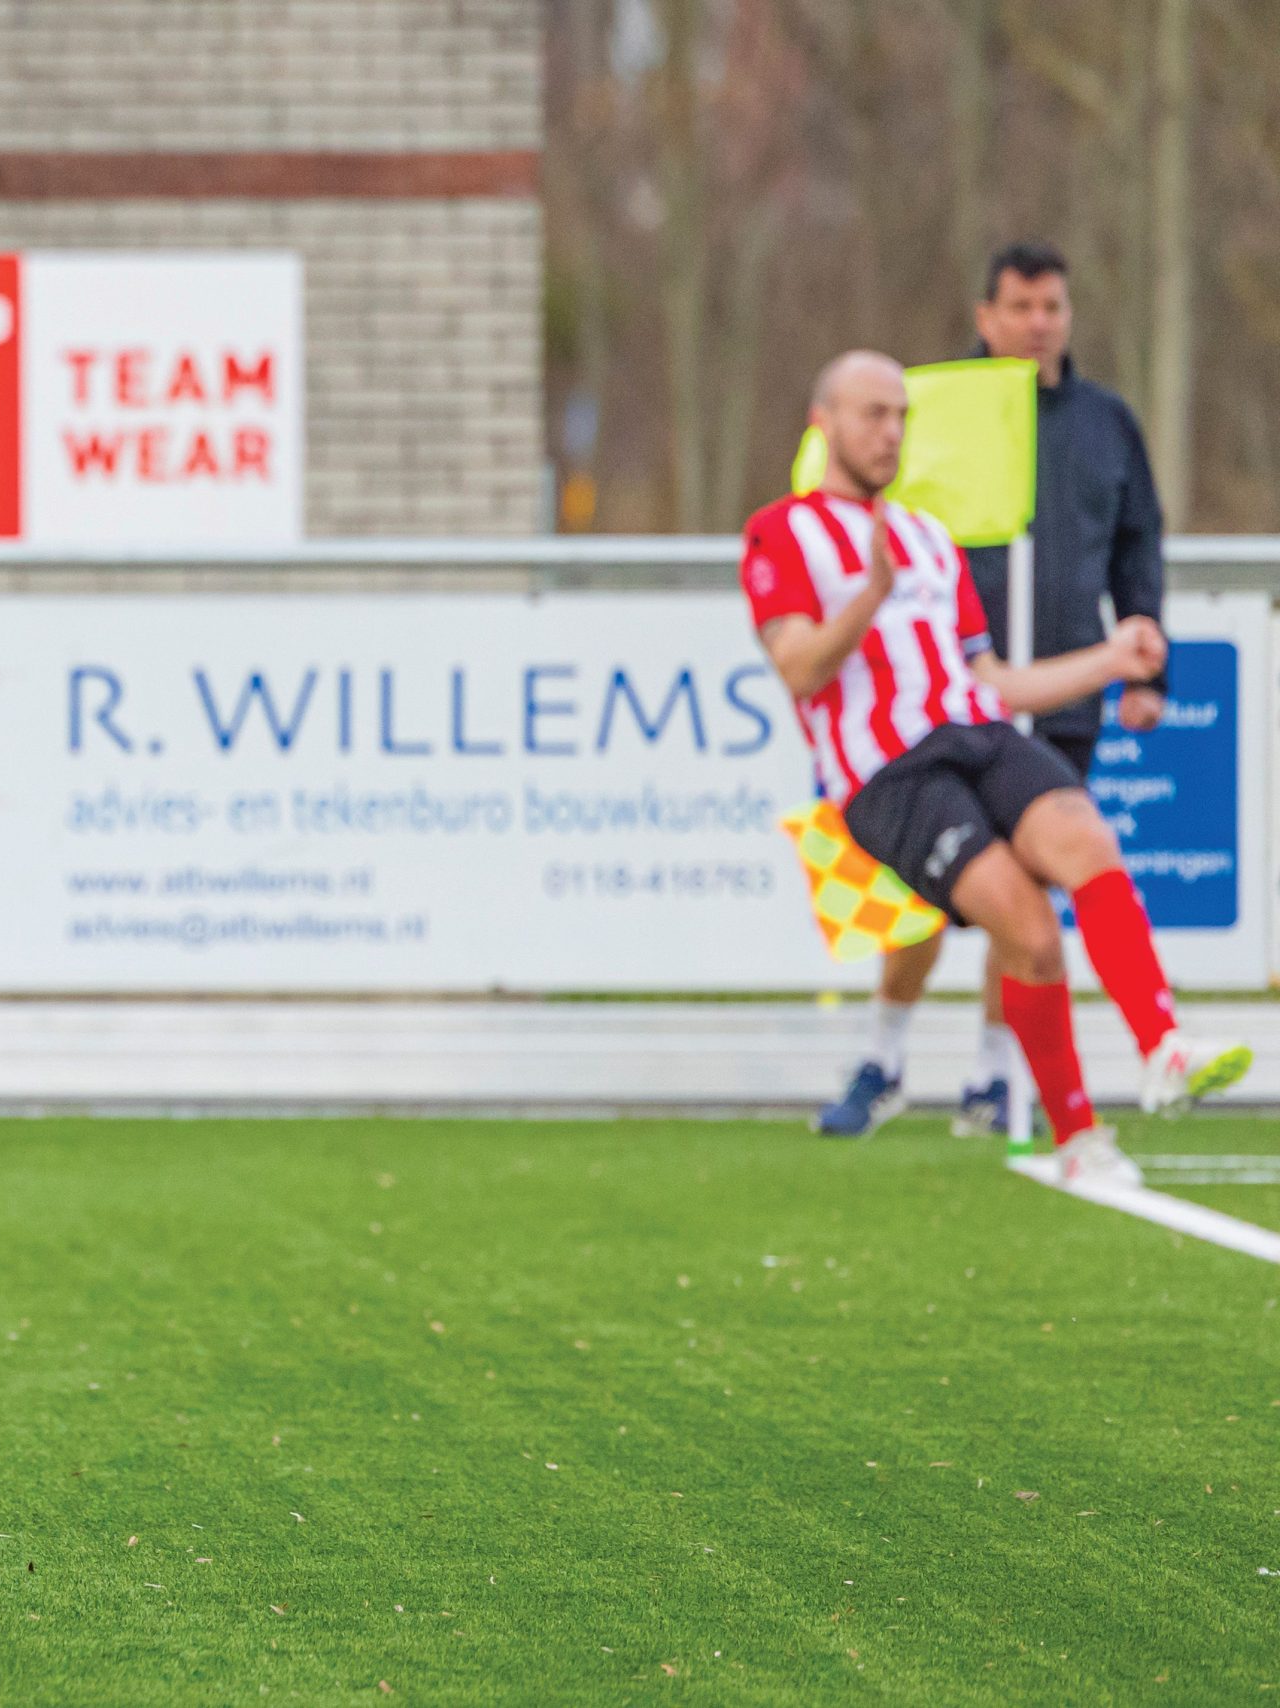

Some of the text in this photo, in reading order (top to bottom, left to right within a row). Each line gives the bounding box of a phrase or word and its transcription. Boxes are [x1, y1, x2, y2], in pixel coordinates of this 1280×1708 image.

[69, 353, 273, 404] TEAM
[67, 429, 270, 480] WEAR
[68, 665, 774, 756] R. WILLEMS
[227, 794, 279, 832] en
[291, 782, 514, 833] tekenburo
[523, 781, 776, 833] bouwkunde
